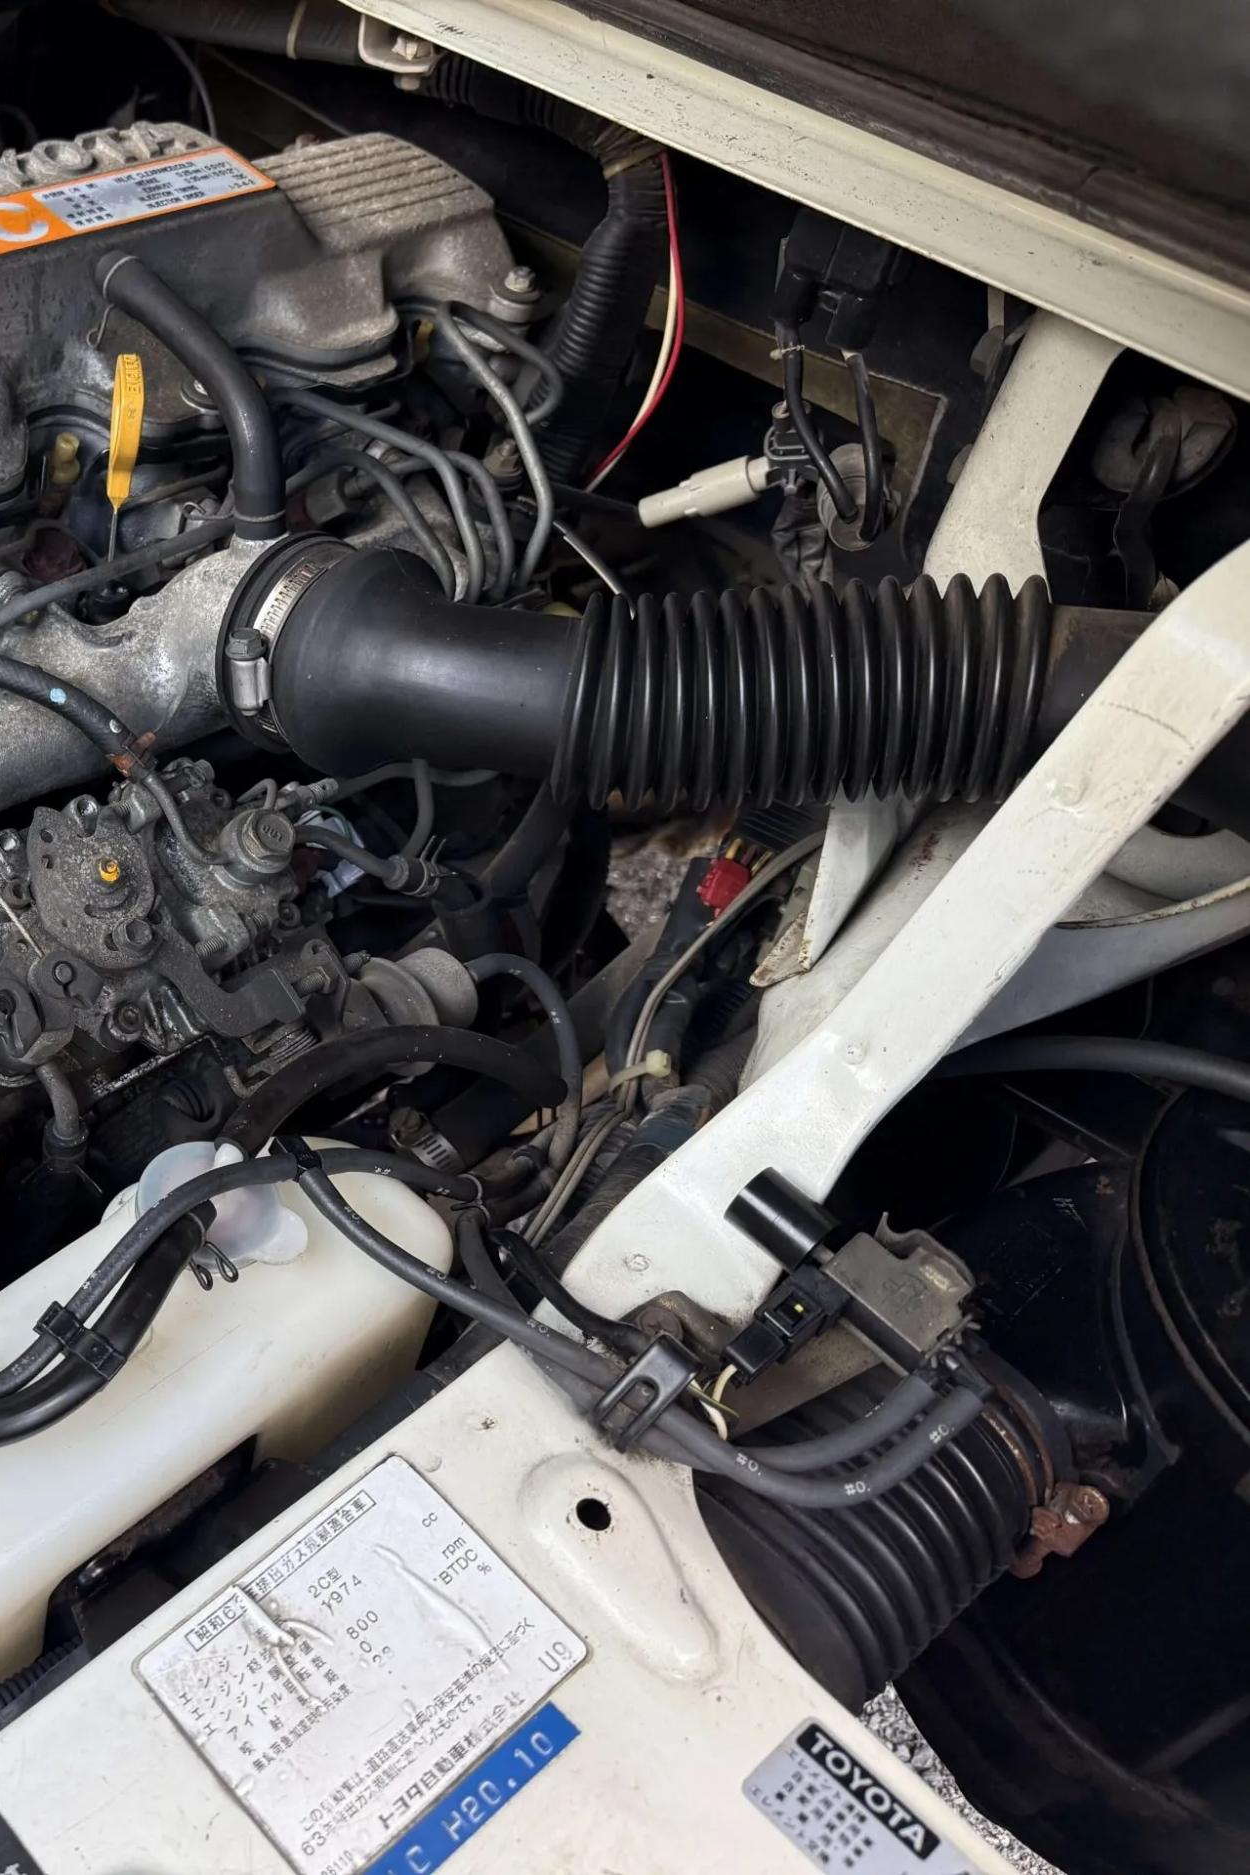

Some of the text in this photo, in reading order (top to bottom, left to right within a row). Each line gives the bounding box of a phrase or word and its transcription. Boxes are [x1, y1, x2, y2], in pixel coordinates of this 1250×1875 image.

[307, 1566, 342, 1598] 2C型
[319, 1574, 362, 1614] 1974
[420, 1510, 439, 1528] cc
[345, 1609, 379, 1640] 800
[440, 1534, 468, 1560] rpm
[476, 1560, 492, 1576] %
[358, 1638, 373, 1655] 0
[812, 1730, 922, 1852] TOYOTA
